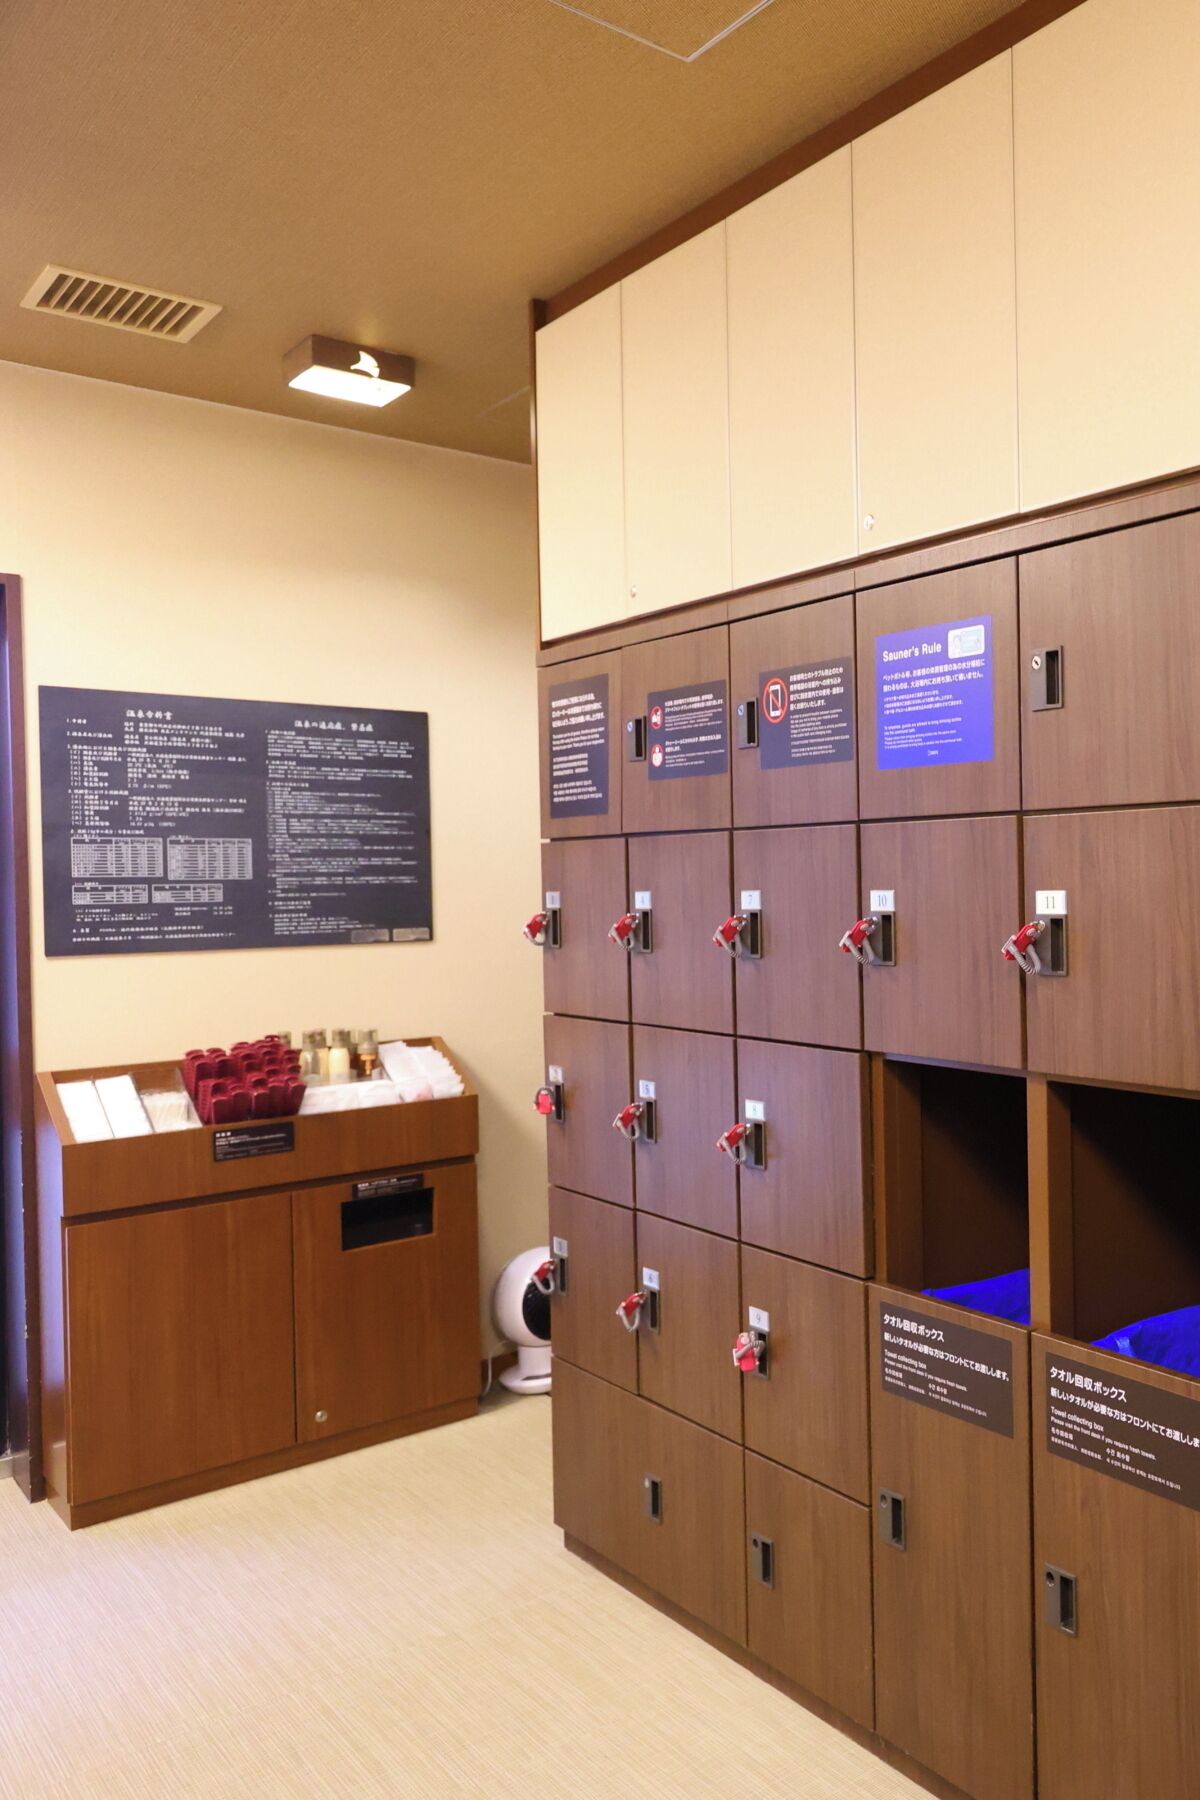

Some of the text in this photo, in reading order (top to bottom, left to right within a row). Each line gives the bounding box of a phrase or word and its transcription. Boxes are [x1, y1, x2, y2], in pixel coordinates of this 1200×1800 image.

[882, 642, 942, 662] Sauner's Rule
[878, 895, 887, 907] 10
[1045, 895, 1055, 910] 11
[883, 1313, 944, 1342] タオル回収ボックス
[884, 1349, 927, 1370] Towel collecting box
[1050, 1366, 1126, 1403] タオル回収ボックス
[1050, 1406, 1104, 1432] Towel collecting box
